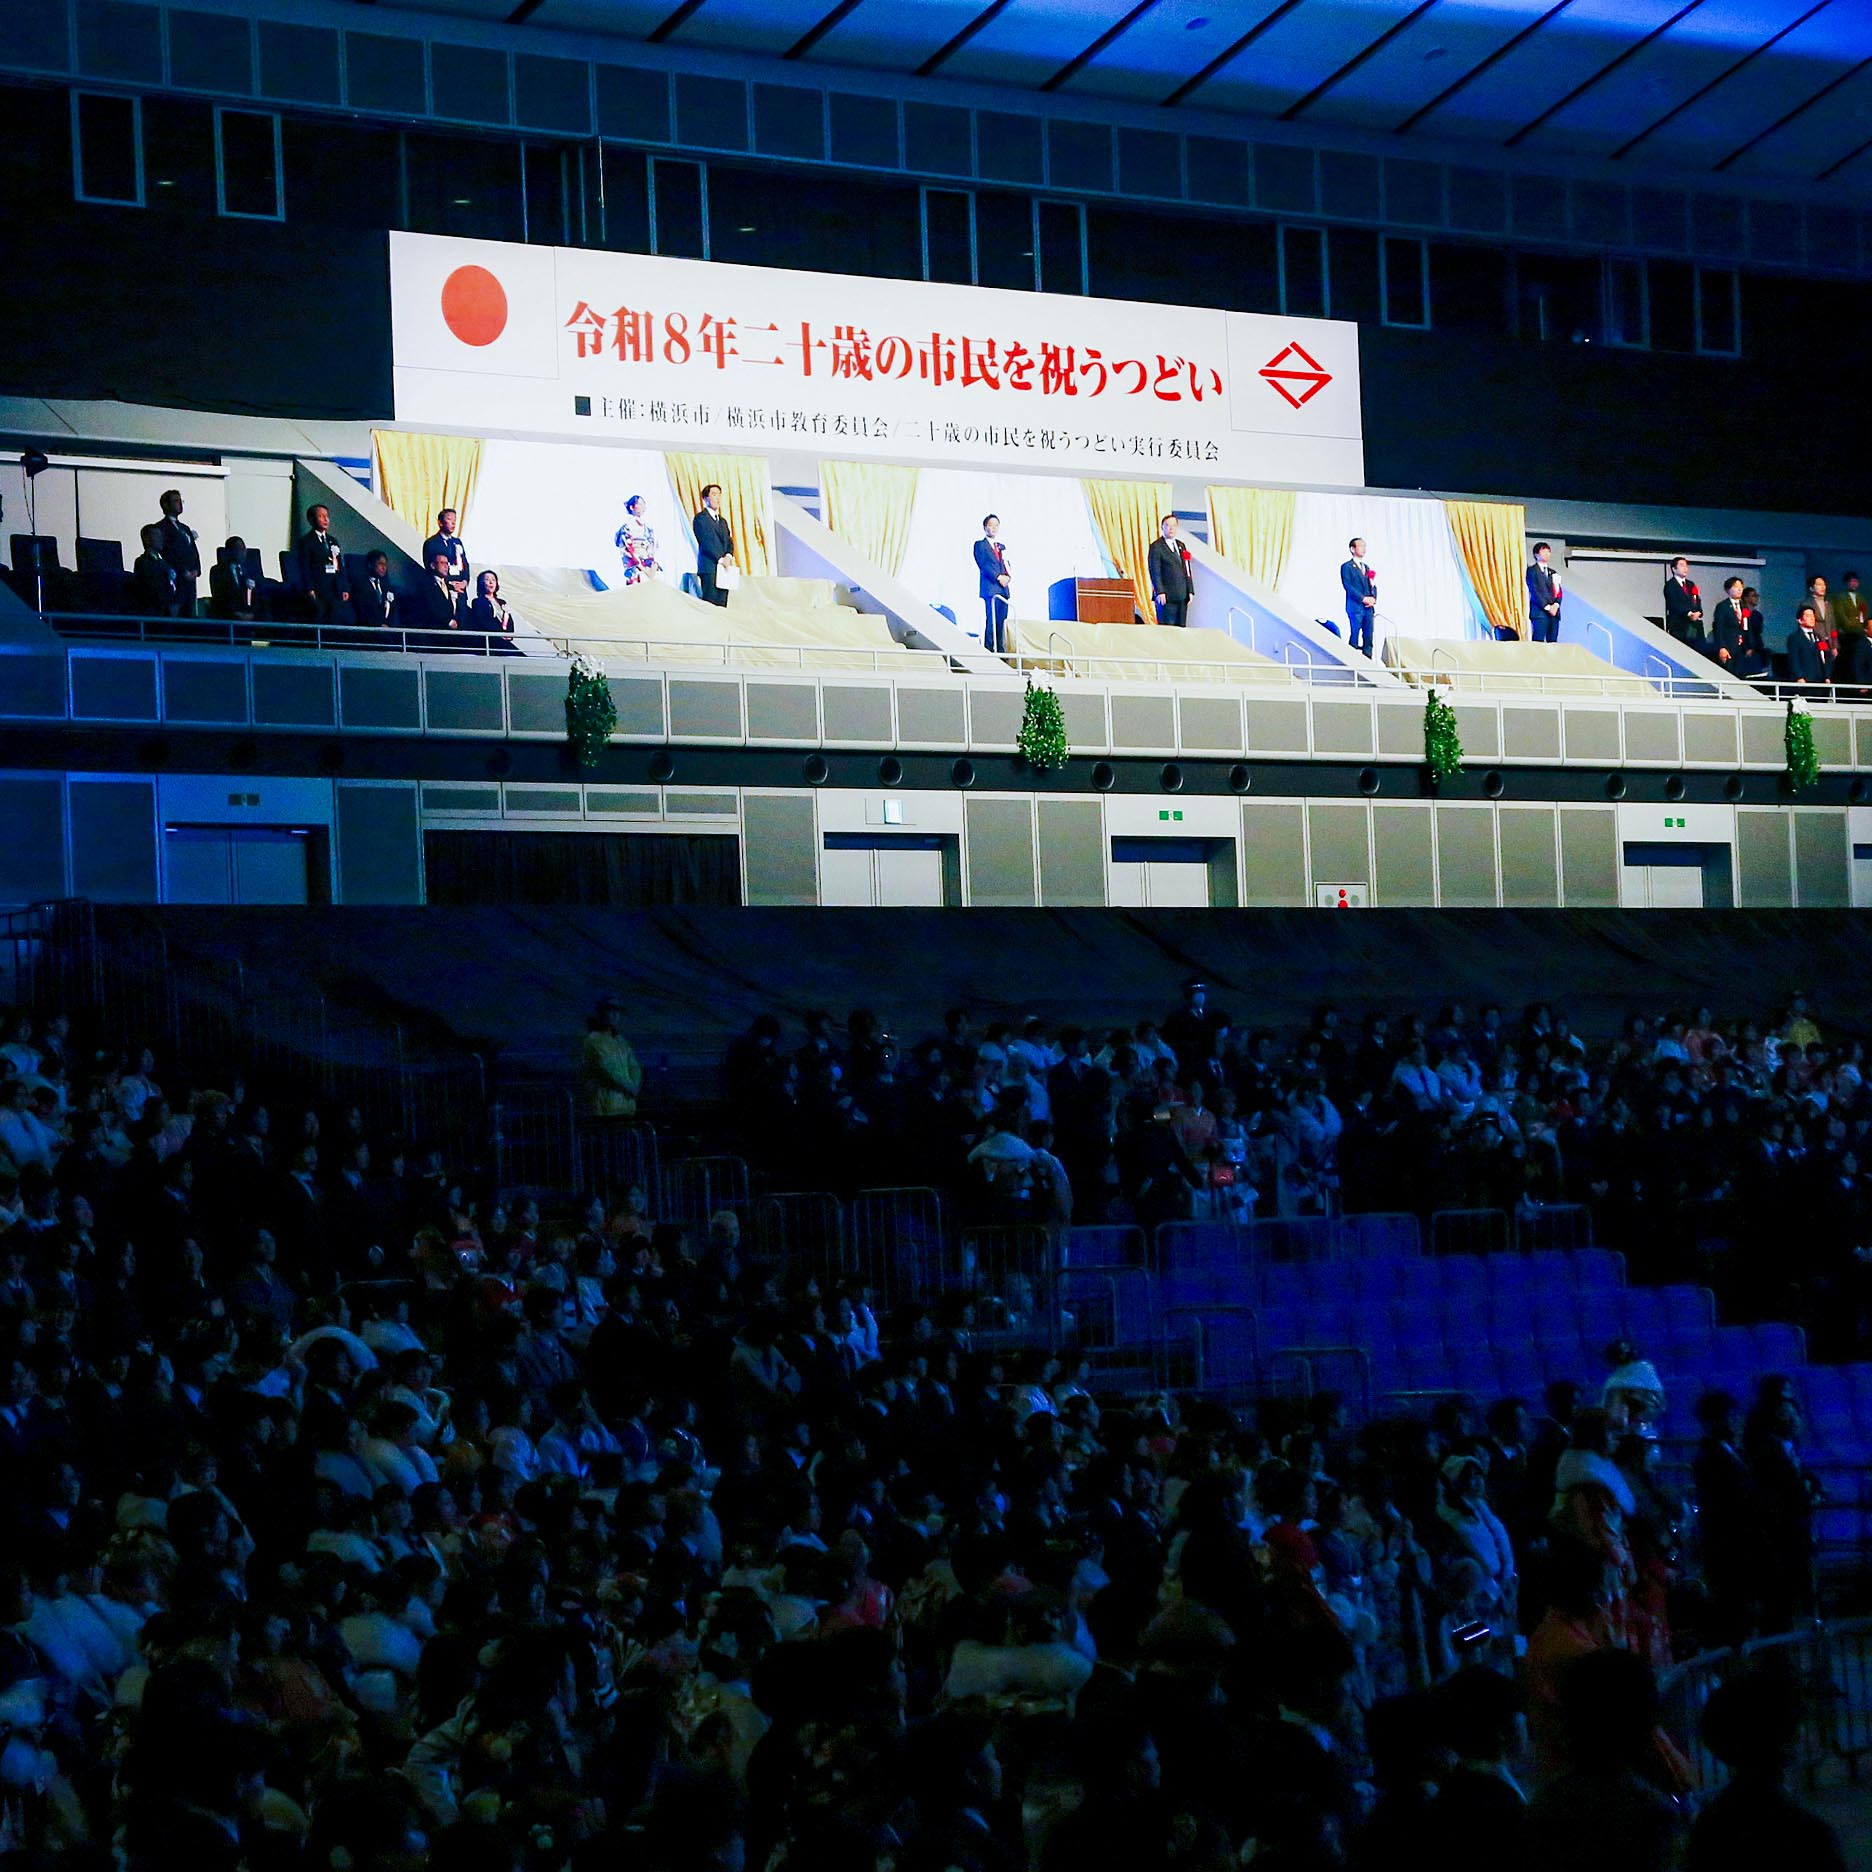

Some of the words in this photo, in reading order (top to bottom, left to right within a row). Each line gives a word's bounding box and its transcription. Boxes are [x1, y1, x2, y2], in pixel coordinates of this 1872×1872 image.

[565, 301, 1223, 402] 令和8年二十歳の市民を祝うつどい
